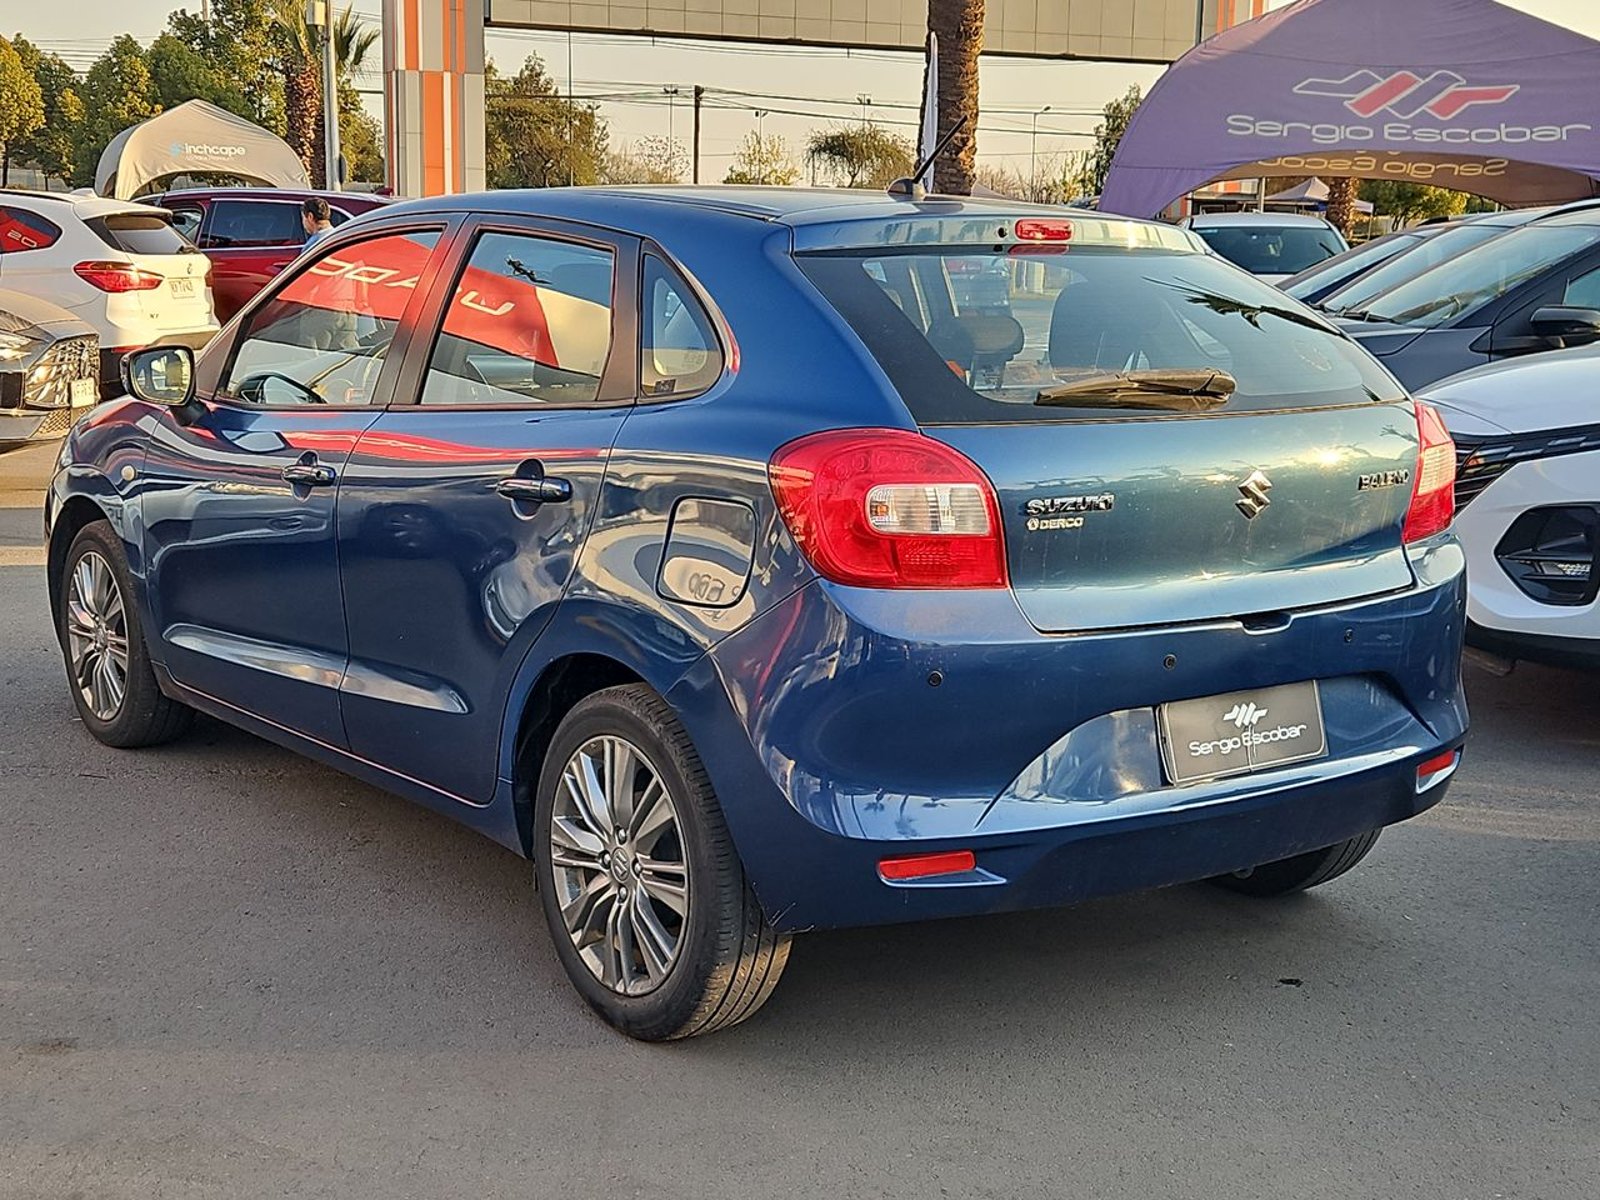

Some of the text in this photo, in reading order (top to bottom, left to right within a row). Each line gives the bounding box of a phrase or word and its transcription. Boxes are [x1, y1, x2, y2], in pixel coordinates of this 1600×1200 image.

[1226, 114, 1592, 144] Sergio Escobar
[184, 143, 246, 157] inchcape
[1241, 724, 1307, 747] Escobar
